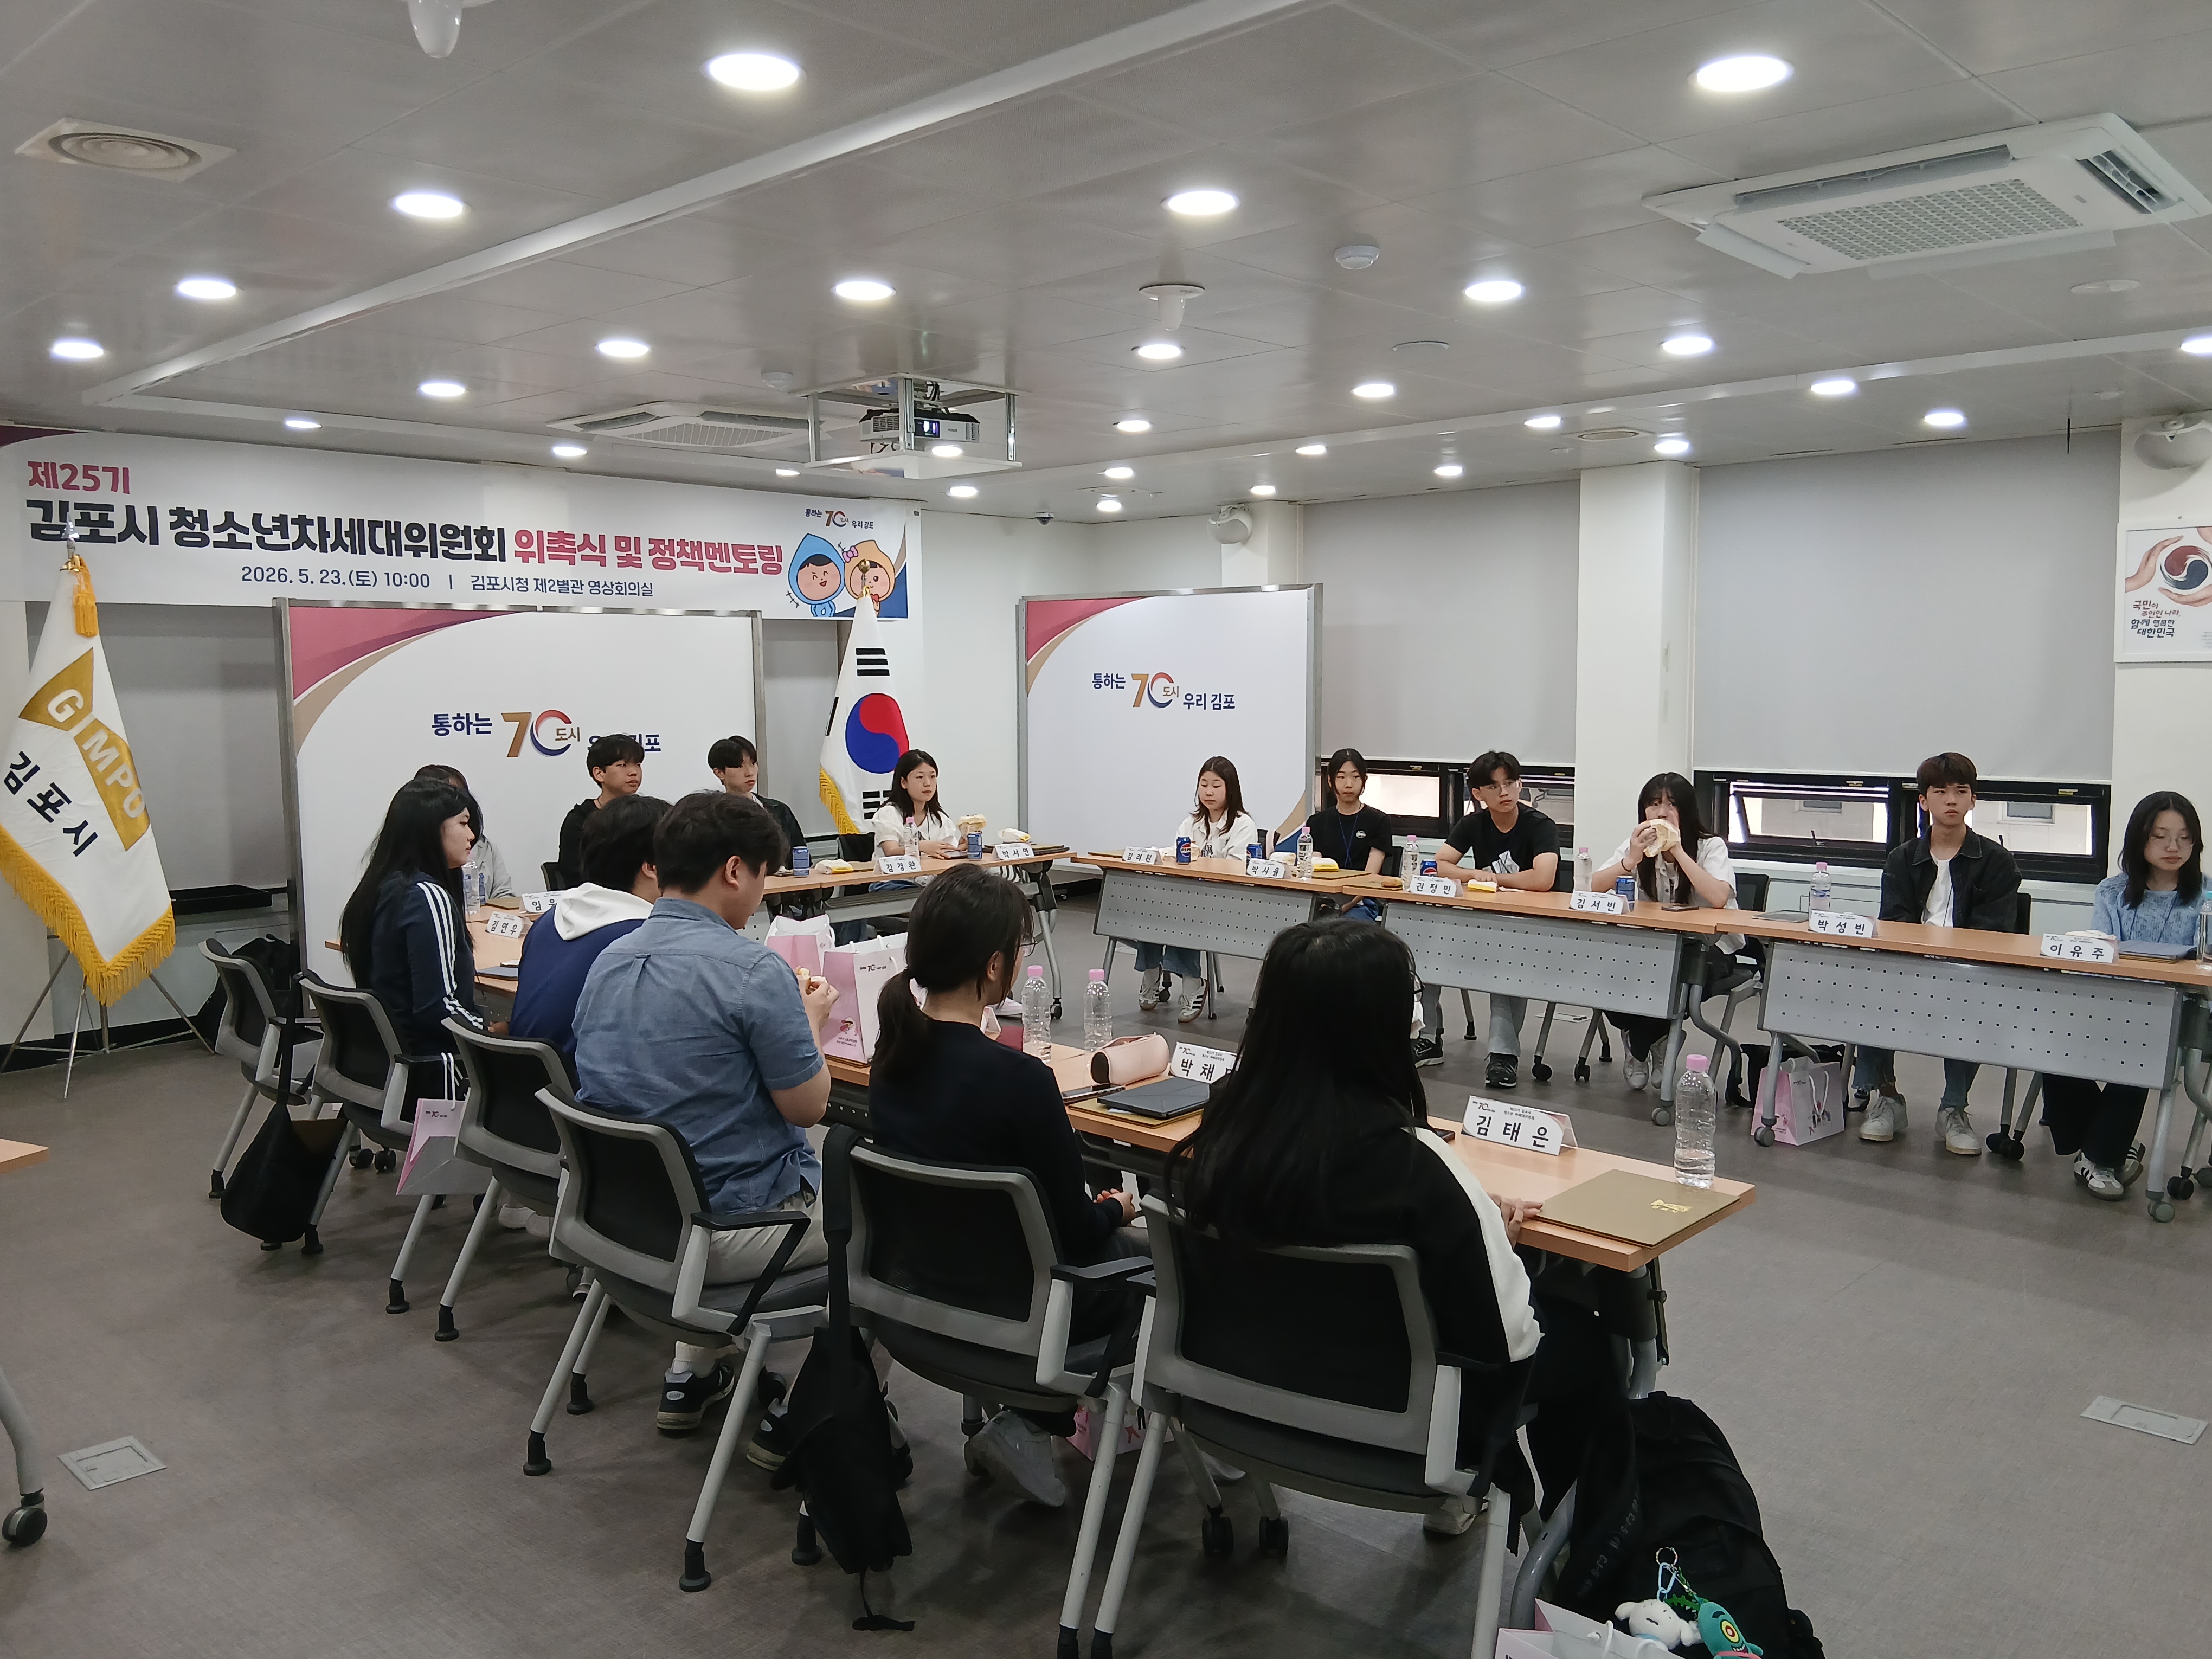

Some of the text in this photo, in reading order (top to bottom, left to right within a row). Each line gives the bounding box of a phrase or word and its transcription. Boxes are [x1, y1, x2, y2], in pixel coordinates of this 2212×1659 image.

[27, 460, 130, 494] 제25기
[25, 499, 783, 575] 김포시 청소년차세대위원회 위촉식 및 정책멘토링
[851, 520, 863, 529] 우리
[864, 521, 874, 529] 김포
[241, 566, 293, 583] 2026.
[299, 568, 314, 584] 5.
[384, 572, 430, 588] 10:00
[471, 575, 529, 593] 김포시청
[533, 578, 584, 594] 제2별관
[588, 580, 653, 597] 영상회의실
[2133, 600, 2158, 610] 국민이
[2137, 627, 2175, 638] 대한민국
[1092, 673, 1126, 690] 통하는
[1162, 686, 1179, 698] 도시
[1183, 693, 1207, 710] 우리
[1211, 693, 1236, 710] 김포
[431, 713, 493, 737] 통하는
[555, 726, 580, 742] 도시
[47, 689, 146, 818] GIMPO
[3, 751, 98, 857] 김포시
[1416, 882, 1451, 895] 권정민
[1577, 898, 1616, 912] 김서빈
[1818, 919, 1865, 935] 박성빈
[2050, 943, 2104, 960] 이유주
[1181, 1058, 1232, 1081] 박채
[1476, 1115, 1549, 1148] 김태은
